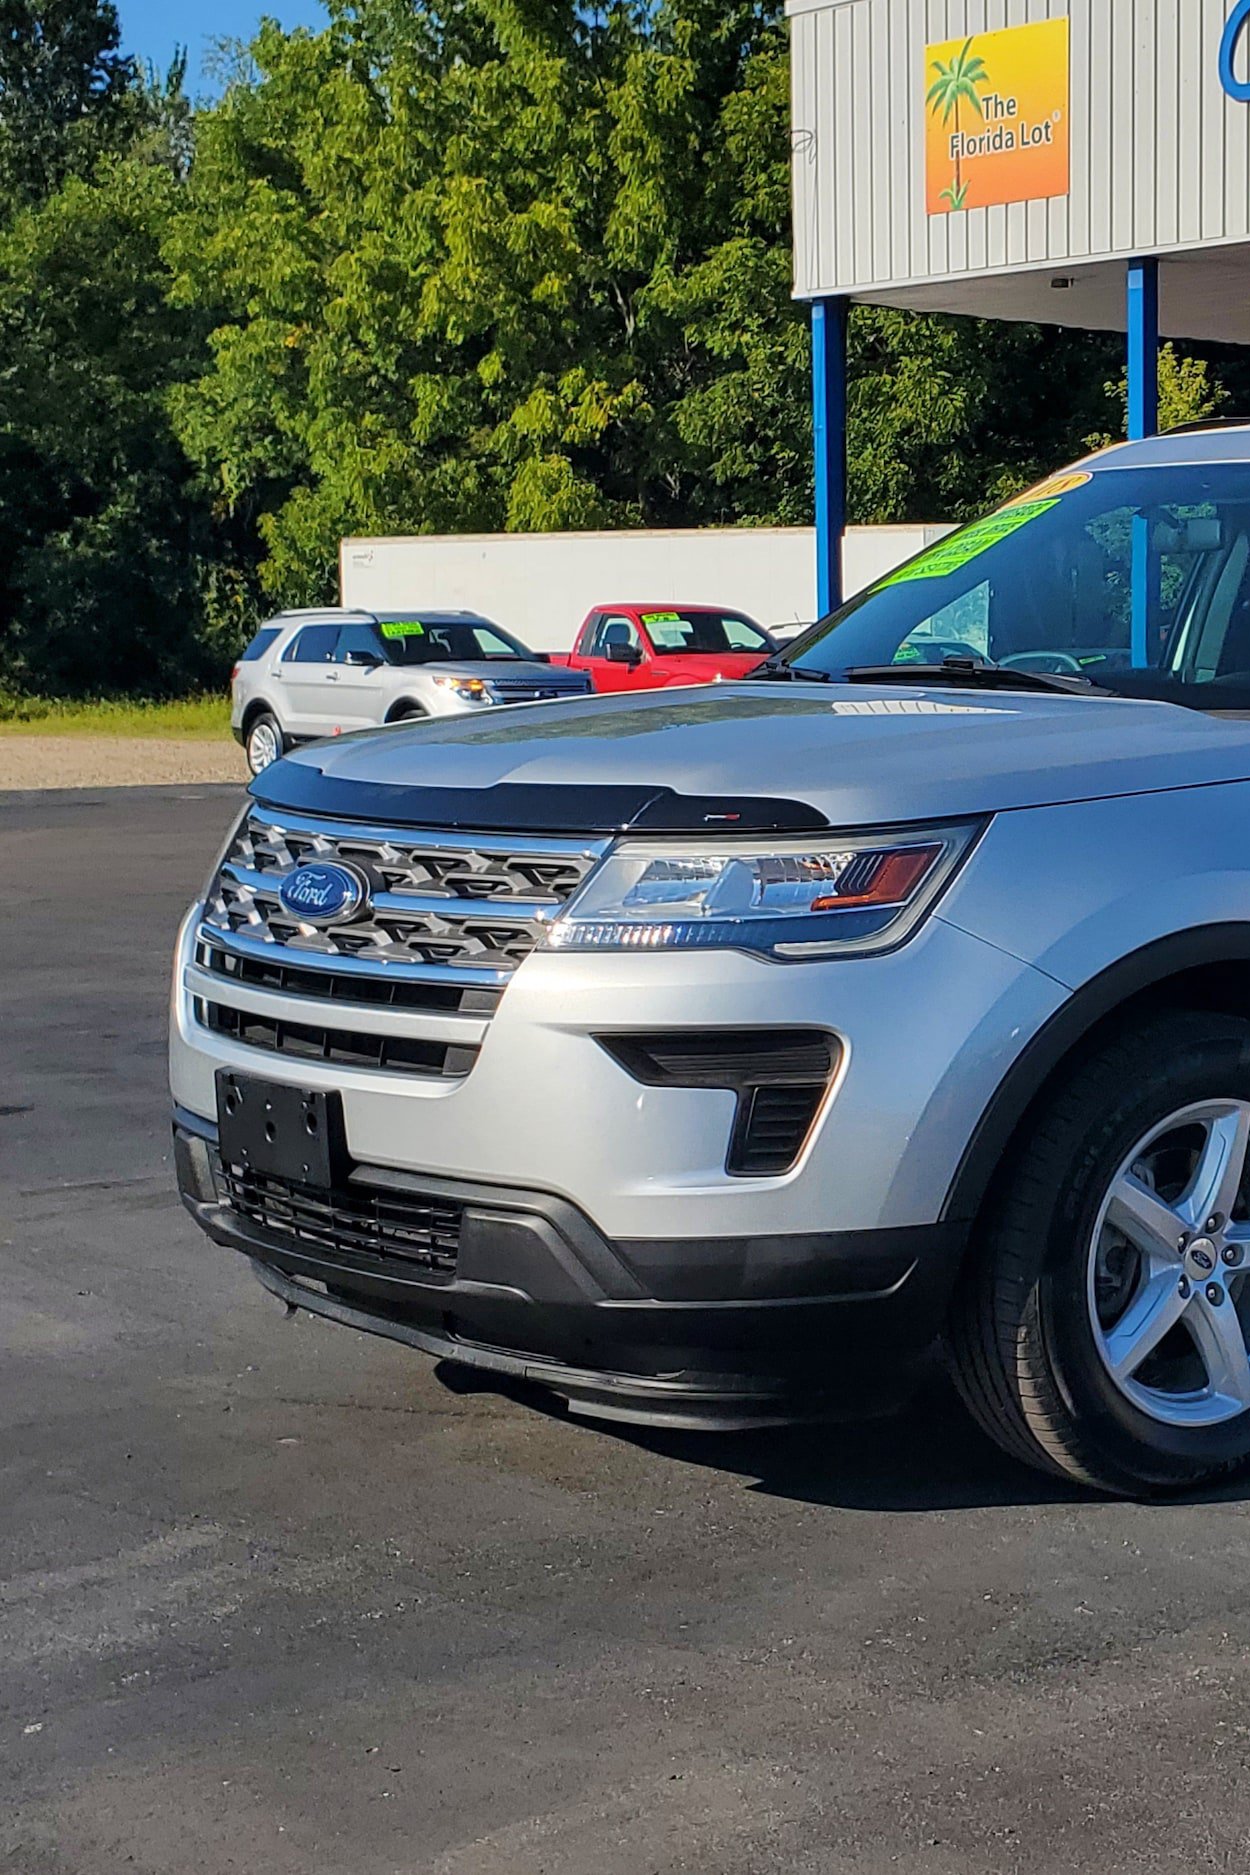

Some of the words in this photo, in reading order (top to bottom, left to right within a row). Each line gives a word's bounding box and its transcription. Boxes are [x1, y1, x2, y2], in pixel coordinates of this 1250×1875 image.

[982, 94, 1016, 120] The
[950, 125, 1014, 158] Florida
[1020, 121, 1051, 146] Lot
[287, 871, 334, 907] Ford
